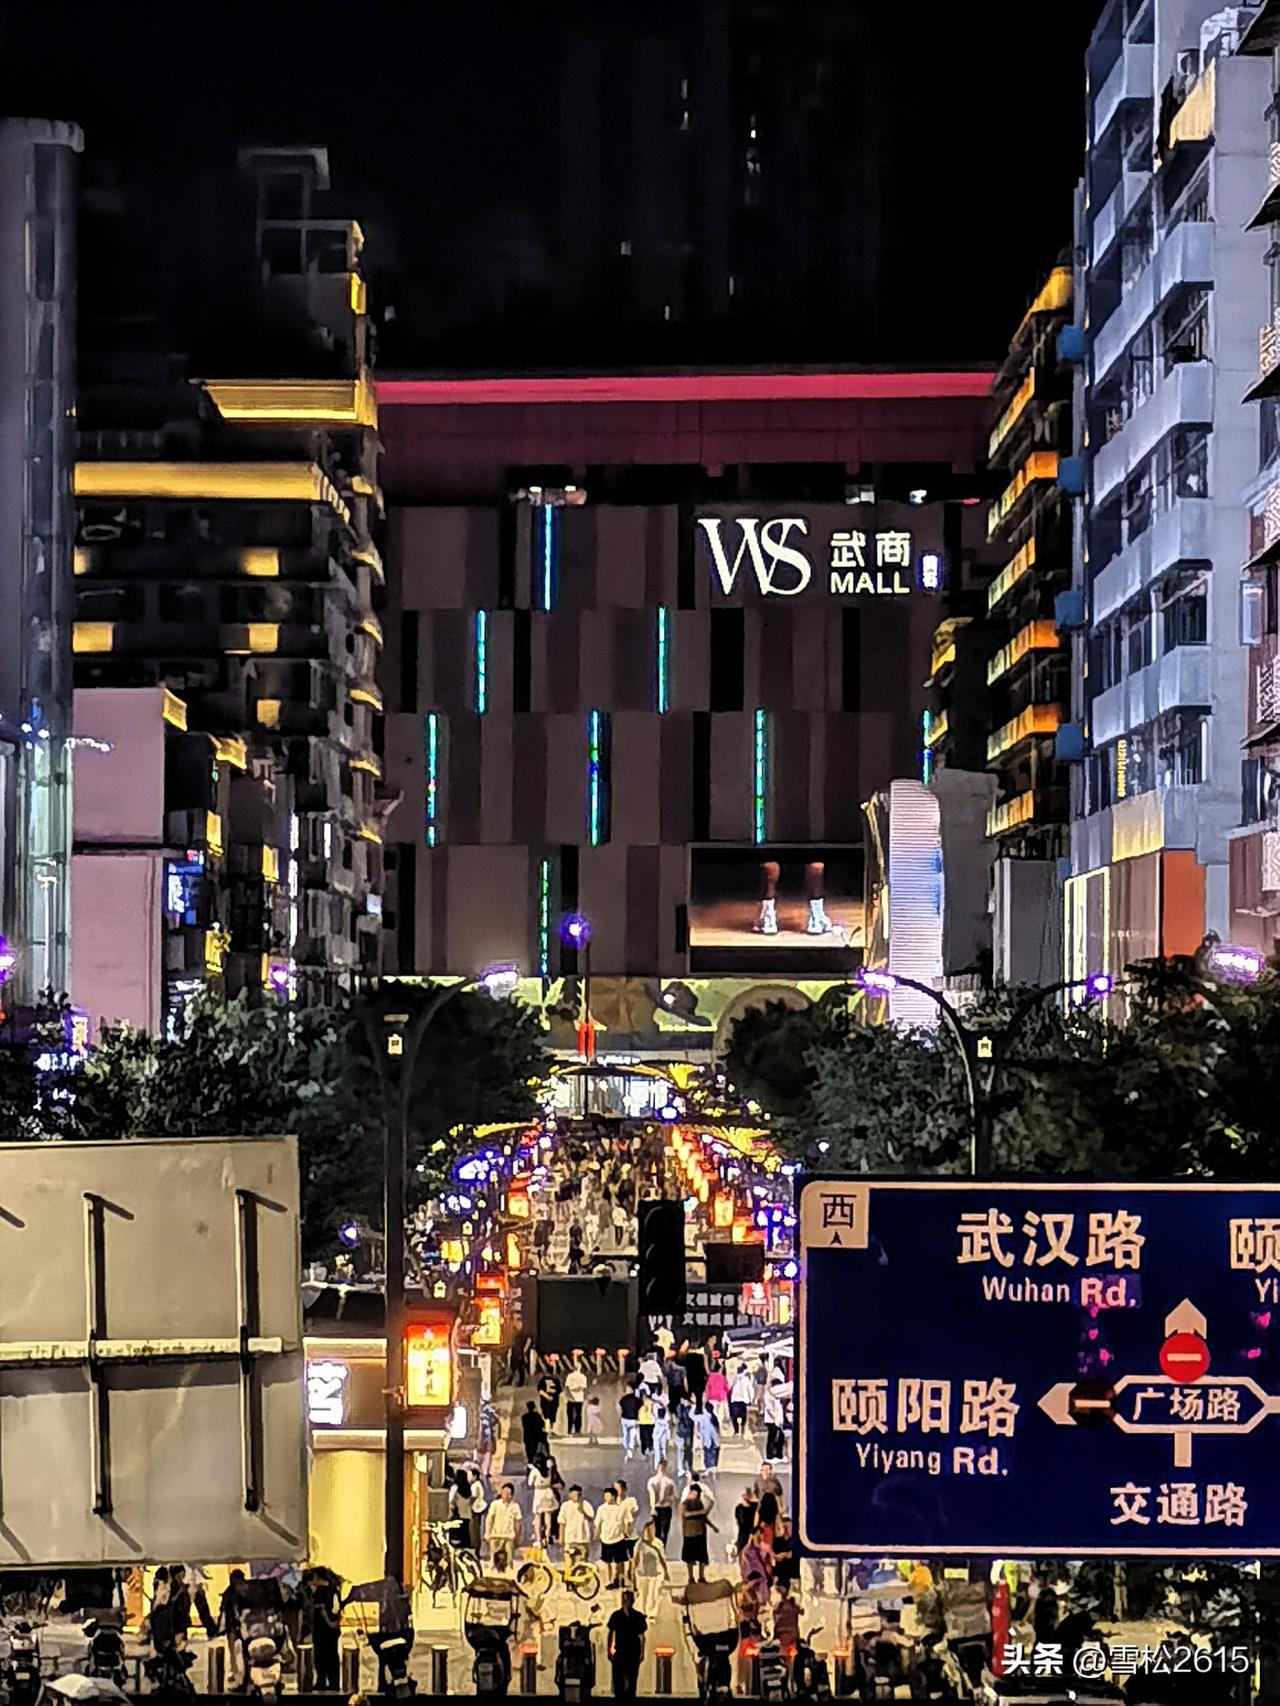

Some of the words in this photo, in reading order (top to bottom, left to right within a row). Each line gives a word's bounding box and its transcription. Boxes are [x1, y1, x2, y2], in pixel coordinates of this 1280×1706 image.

[697, 518, 812, 595] WS
[830, 530, 911, 568] 武商
[830, 571, 911, 594] MALL
[820, 1193, 855, 1229] 西
[956, 1207, 1146, 1270] 武汉路
[982, 1275, 1070, 1303] Wuhan
[1081, 1277, 1137, 1308] Rd.
[831, 1377, 1020, 1438] 颐阳路
[1132, 1387, 1241, 1422] 广场路
[855, 1442, 941, 1475] Yiyang
[953, 1446, 1009, 1476] Rd.
[1110, 1482, 1248, 1527] 交通路
